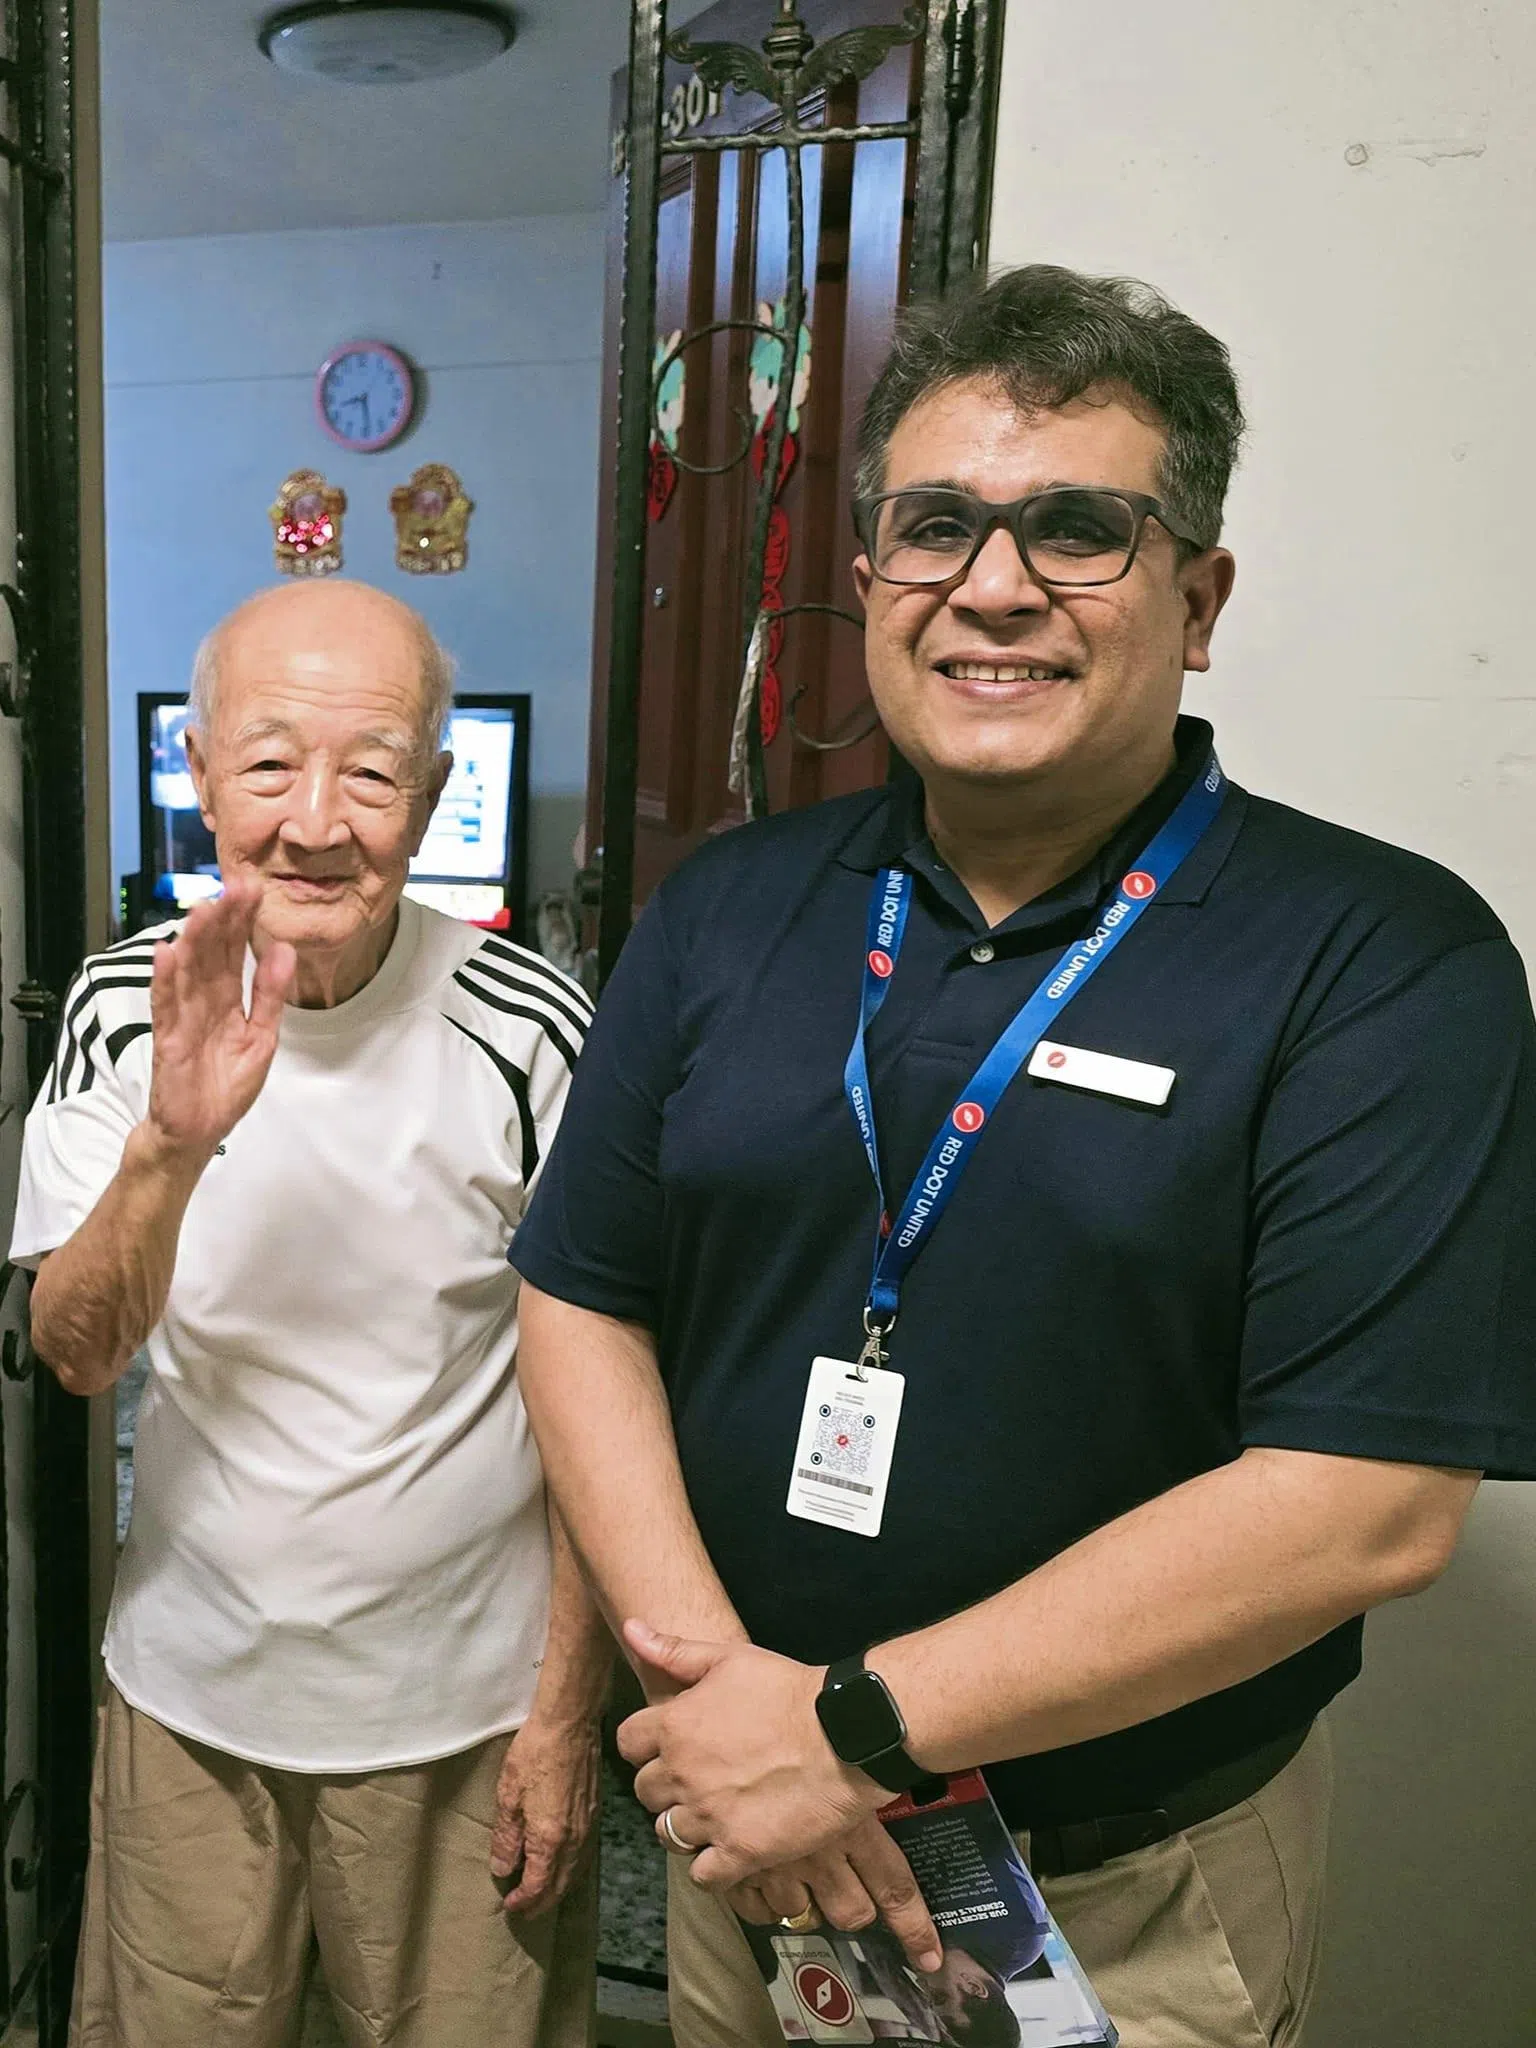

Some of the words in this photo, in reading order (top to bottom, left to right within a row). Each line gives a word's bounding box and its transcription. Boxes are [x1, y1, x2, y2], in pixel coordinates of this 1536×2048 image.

[880, 895, 900, 923] DOT
[1103, 900, 1132, 928] RED
[876, 922, 895, 948] RED
[1081, 926, 1112, 956] DOT
[1046, 954, 1091, 1000] UNITED
[851, 1085, 871, 1139] UNITED
[938, 1135, 964, 1166] RED
[922, 1165, 949, 1200] DOT
[897, 1198, 934, 1248] UNITED
[939, 1912, 989, 1928] SECRETARY-
[958, 1900, 1005, 1916] GENERAL'S
[989, 1908, 1009, 1920] OUR
